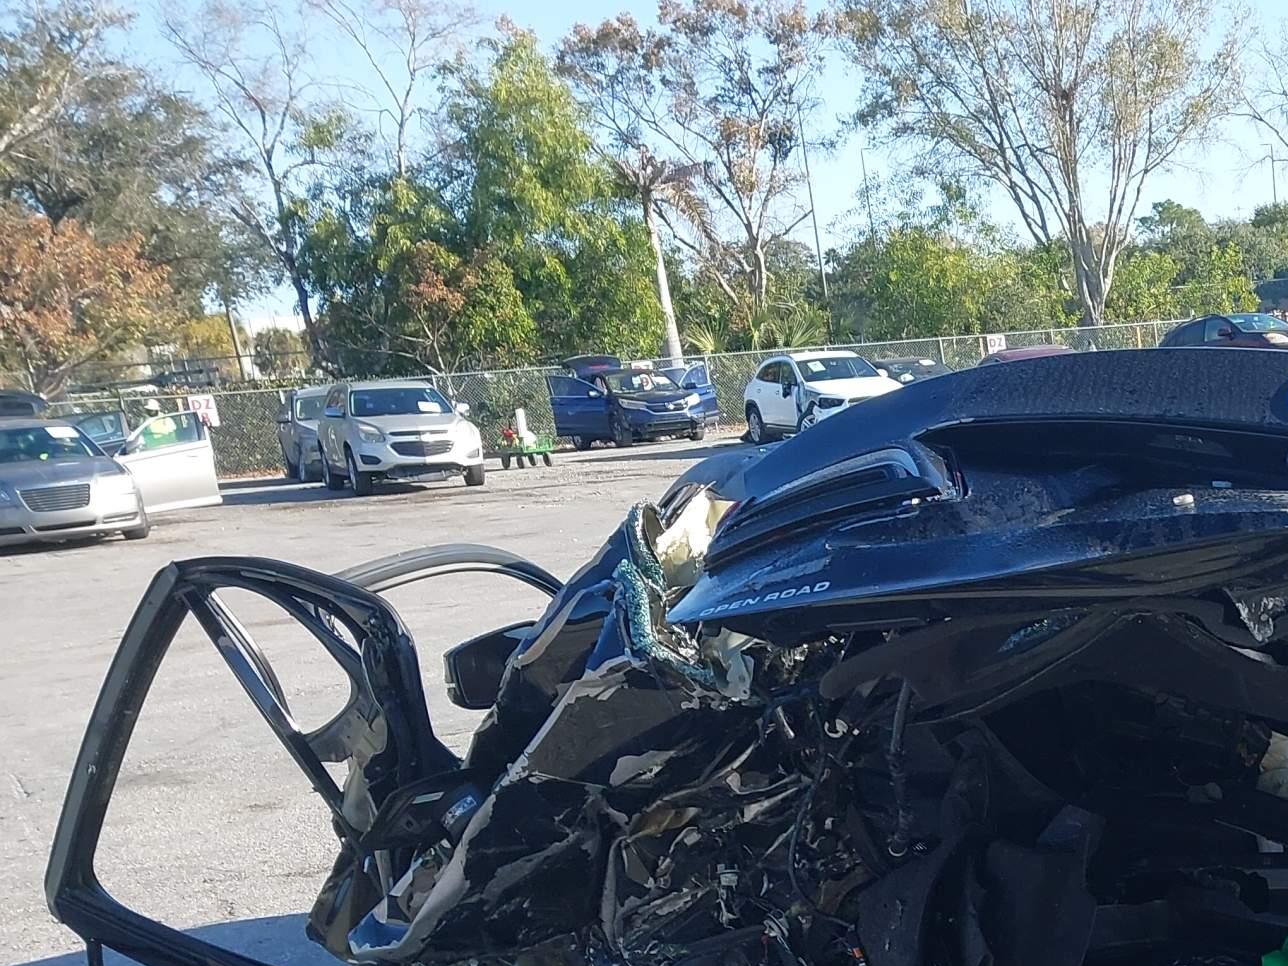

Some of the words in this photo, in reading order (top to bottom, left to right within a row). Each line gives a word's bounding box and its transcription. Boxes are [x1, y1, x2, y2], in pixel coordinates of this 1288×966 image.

[989, 336, 1004, 348] DZ
[191, 398, 214, 410] DZ
[699, 597, 760, 617] OPEN
[763, 581, 831, 602] ROAD
